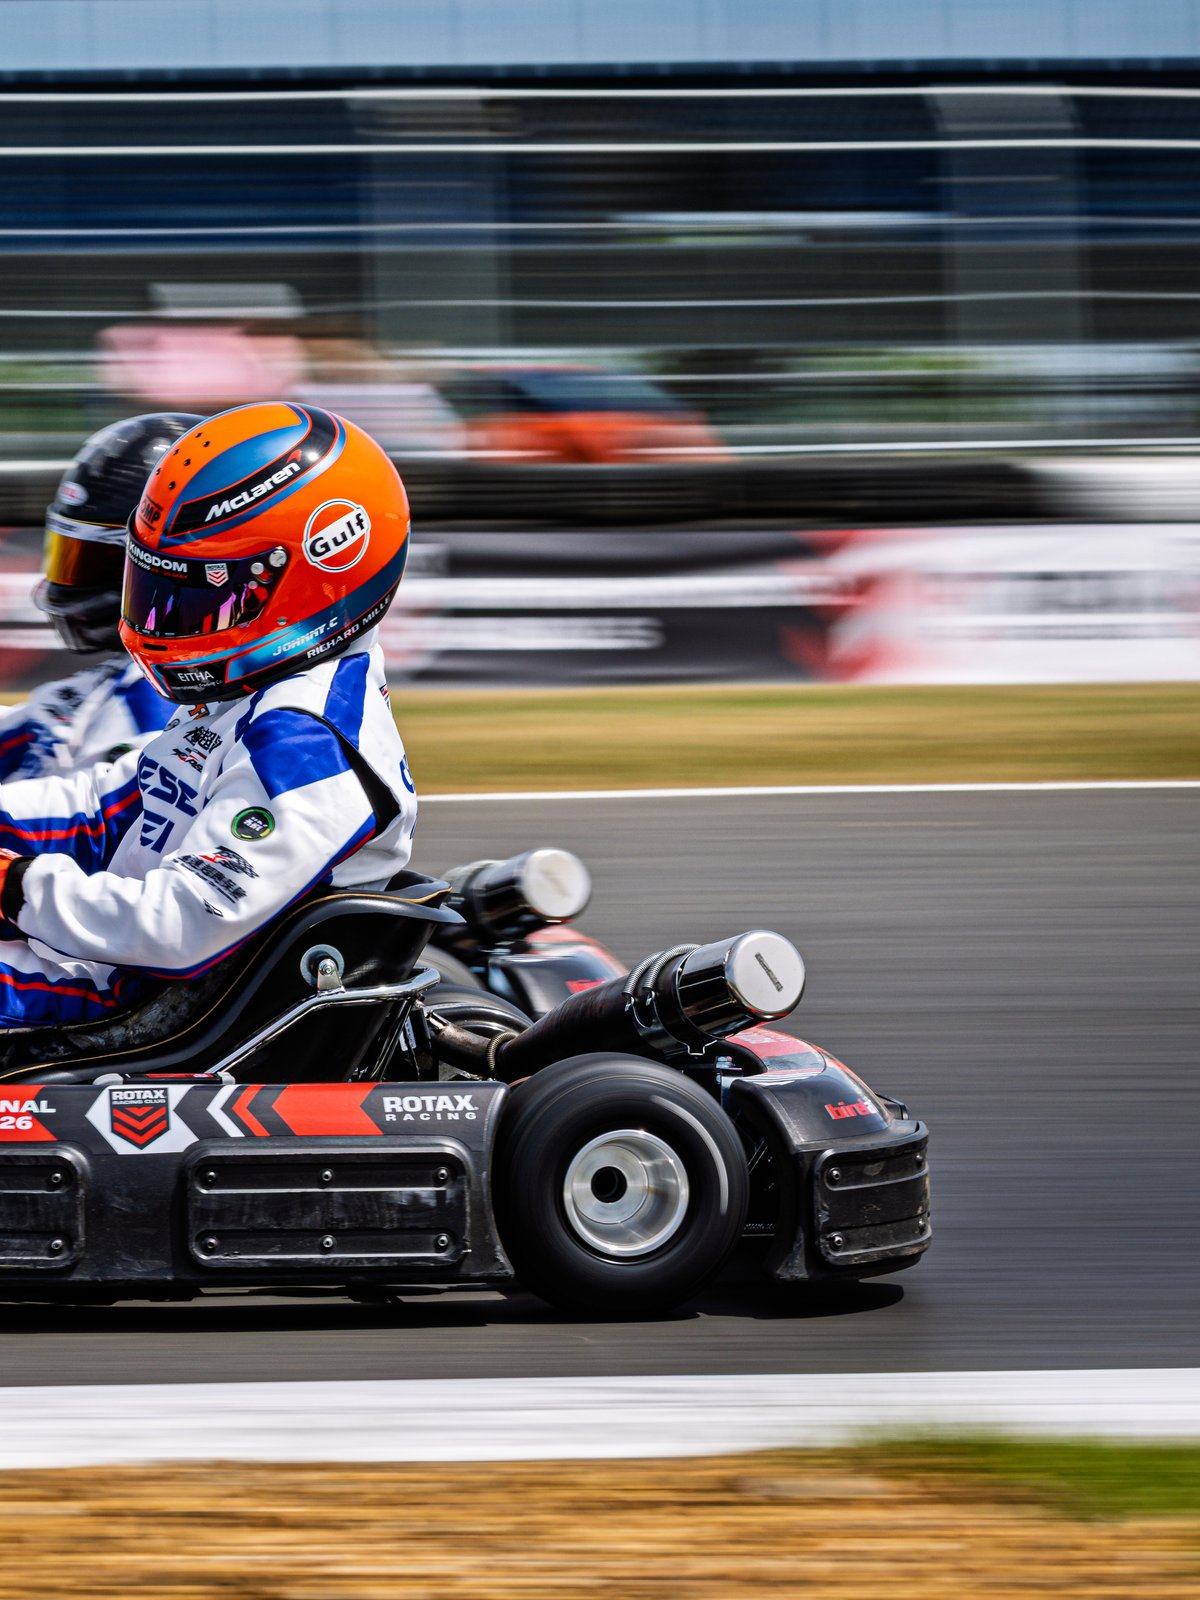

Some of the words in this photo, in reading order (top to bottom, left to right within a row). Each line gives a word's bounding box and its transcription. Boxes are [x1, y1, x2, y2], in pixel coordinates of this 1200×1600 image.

[204, 462, 301, 523] McLaren
[308, 512, 365, 558] Gulf
[128, 540, 188, 573] KINGDOM
[306, 623, 360, 659] RICHARD
[177, 670, 215, 682] EITHA
[111, 1089, 166, 1100] ROTAX
[382, 1094, 477, 1113] ROTAX
[384, 1111, 477, 1122] RACING
